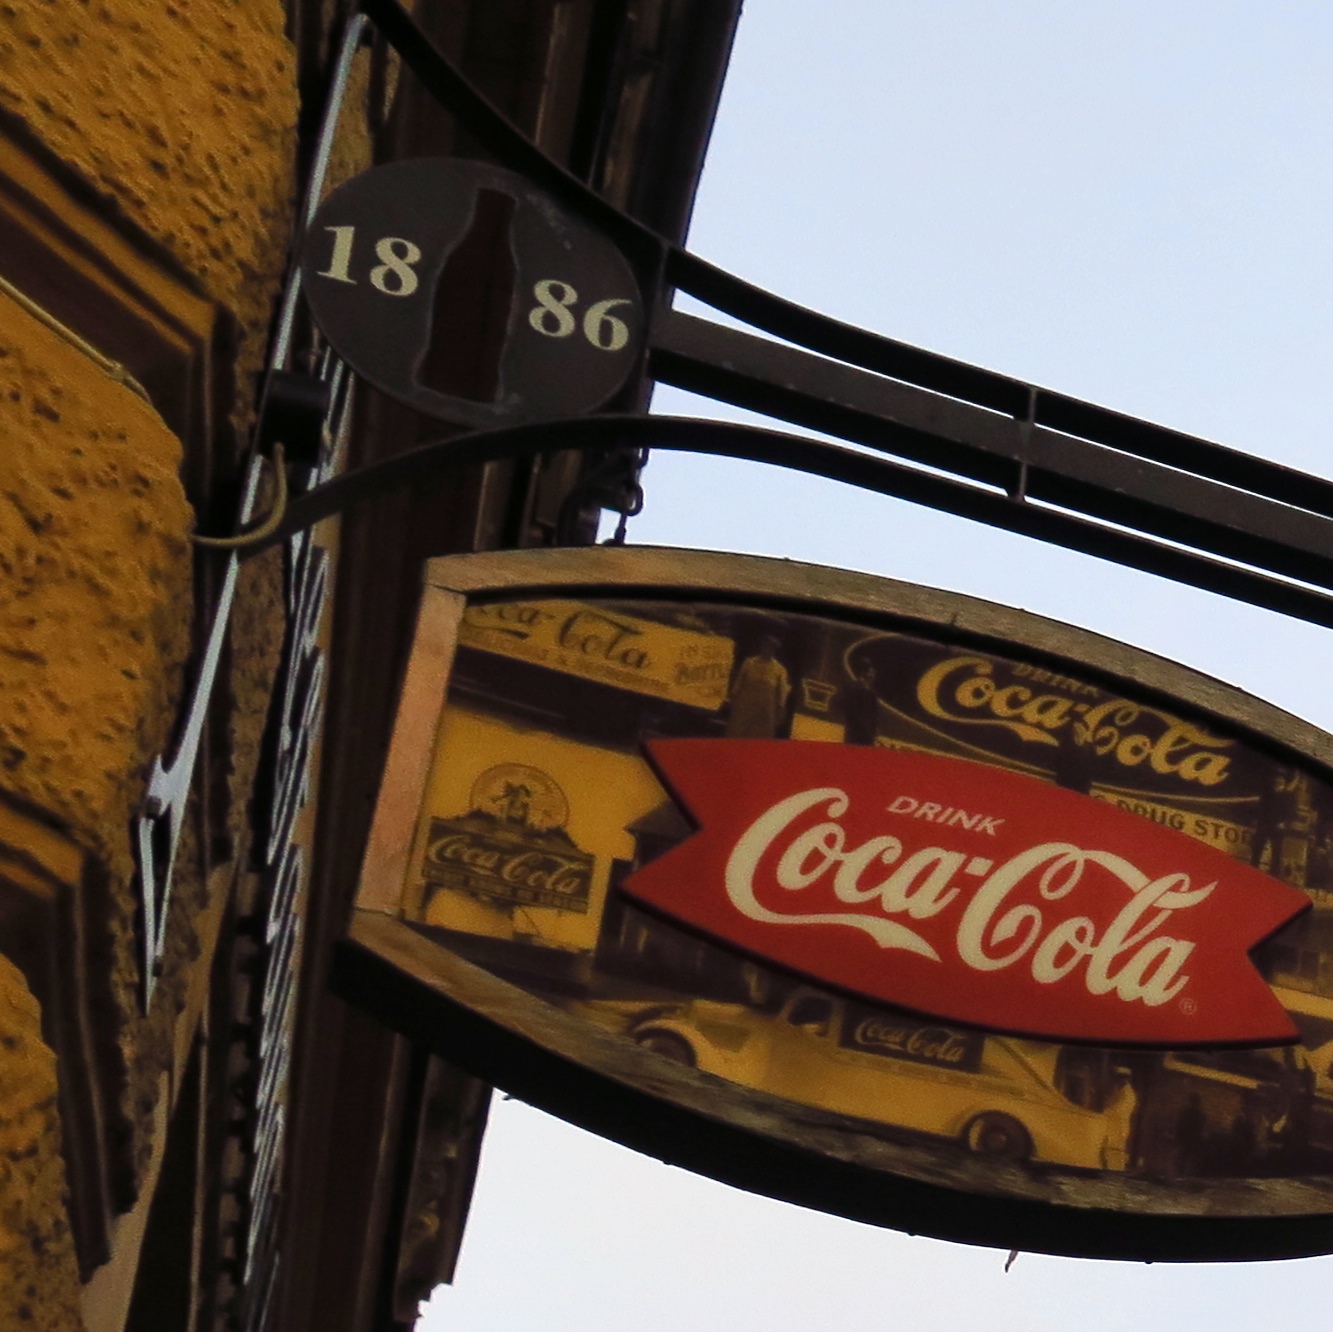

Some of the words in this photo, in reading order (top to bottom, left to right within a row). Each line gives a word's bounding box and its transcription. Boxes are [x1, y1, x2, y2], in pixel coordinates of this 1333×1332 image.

[316, 225, 422, 298] 18
[528, 278, 633, 351] 86
[916, 656, 1237, 787] Coca-Cola
[886, 796, 1005, 836] DRINK
[724, 787, 1219, 1007] Coca-Cola
